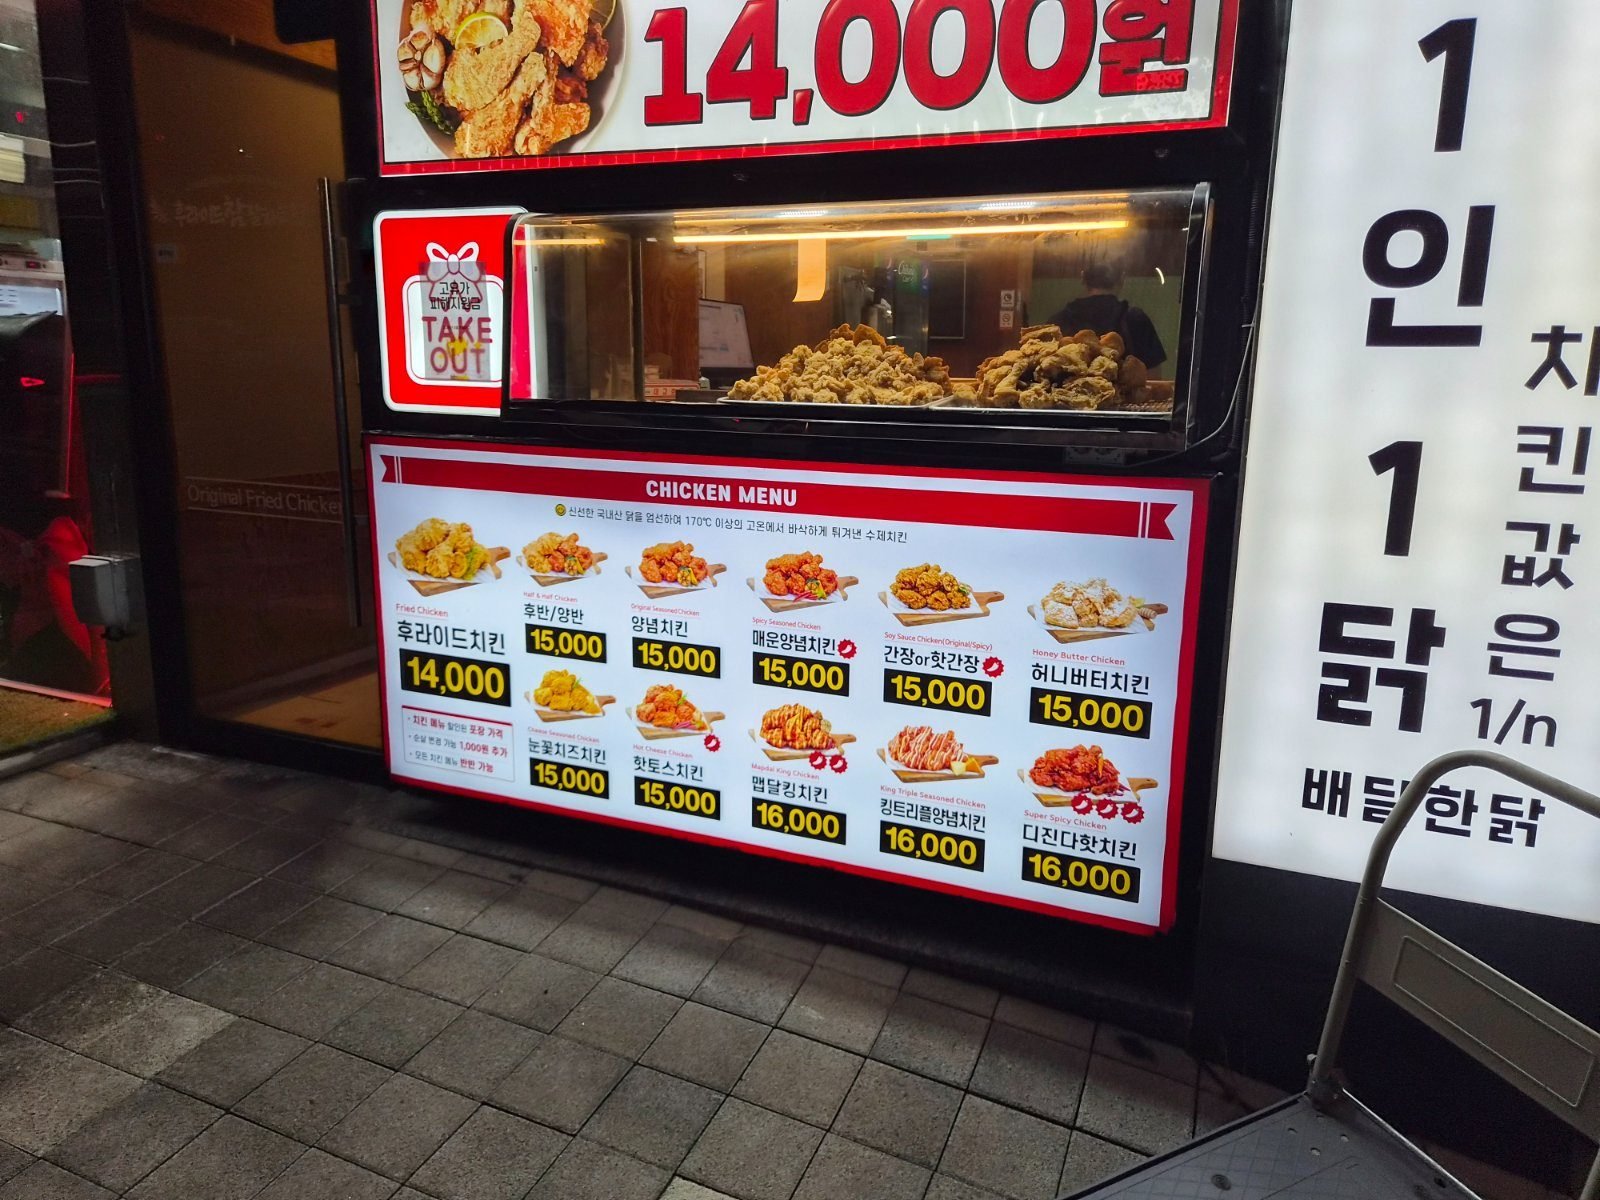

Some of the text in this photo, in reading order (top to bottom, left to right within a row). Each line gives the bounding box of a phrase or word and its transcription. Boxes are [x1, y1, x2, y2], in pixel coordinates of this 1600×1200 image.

[643, 0, 1195, 126] 14,000원
[421, 316, 493, 344] TAKE
[430, 346, 486, 375] OUT
[187, 484, 242, 507] Original
[246, 489, 283, 510] Fried
[645, 479, 797, 507] CHICKEN MENU
[568, 506, 594, 518] 신선한
[597, 508, 623, 521] 국내산
[625, 510, 643, 523] 닭을
[646, 512, 682, 525] 엄선하여
[715, 517, 743, 530] 이상의
[746, 520, 784, 534] 고온에서
[788, 523, 828, 537] 바삭하게
[831, 526, 862, 540] 튀겨낸
[865, 529, 908, 544] 수제치킨
[395, 603, 449, 617] Fried Chicken
[524, 602, 584, 625] 후반/양반
[397, 619, 505, 656] 후라이드치킨
[631, 615, 688, 638] 양념치킨
[530, 628, 603, 659] 15,000
[637, 642, 716, 673] 15,000
[752, 629, 836, 656] 매운양념치킨
[1032, 648, 1126, 666] Honey Butter Chicken
[758, 657, 844, 691] 15,000
[883, 645, 980, 674] 간장or핫간장
[406, 656, 505, 699] 14,000
[890, 674, 986, 710] 15,000
[1031, 662, 1150, 696] 허니버터치킨
[1038, 694, 1144, 732] 15,000
[1469, 697, 1558, 748] 1/n
[528, 737, 606, 765] 눈꽃치즈치킨
[534, 762, 606, 794] 15,000
[633, 755, 703, 782] 핫토스치킨
[639, 781, 716, 815] 15,000
[752, 775, 828, 804] 맵달킹치킨
[756, 802, 840, 839] 16,000
[880, 798, 986, 834] 킹트리플양념치킨
[1024, 809, 1107, 831] Super Spicy Chicken
[885, 826, 977, 865] 16,000
[1022, 823, 1137, 861] 디진다핫치킨
[1028, 853, 1131, 895] 16,000
